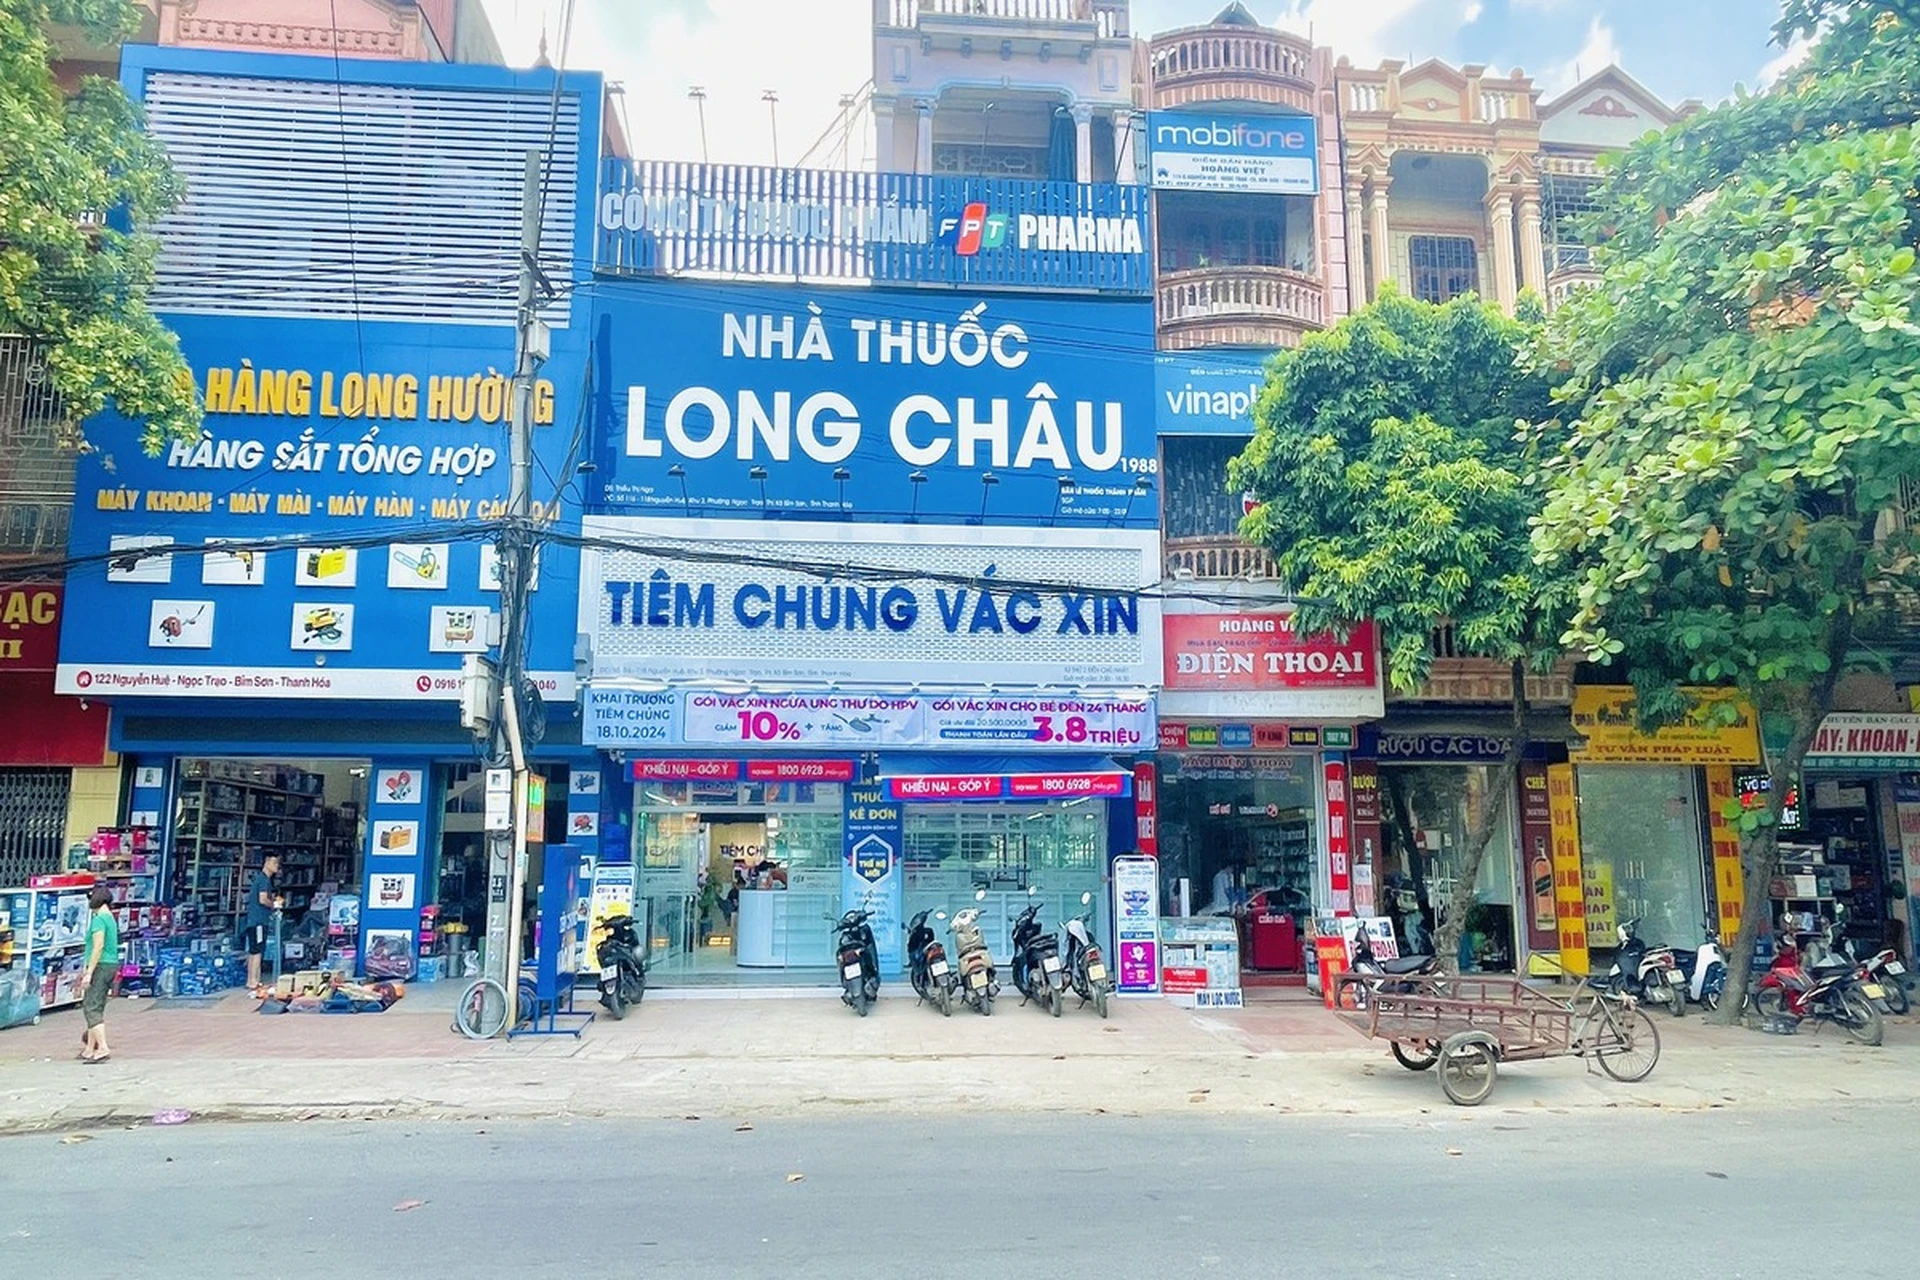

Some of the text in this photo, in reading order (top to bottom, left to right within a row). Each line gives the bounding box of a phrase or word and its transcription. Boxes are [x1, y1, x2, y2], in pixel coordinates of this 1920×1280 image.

[1157, 121, 1305, 149] mobifone
[1201, 165, 1266, 175] HOÀNG VIỆT
[601, 187, 688, 232] CÔNG
[700, 199, 737, 234] TY
[842, 191, 926, 244] PHẨM
[1018, 213, 1143, 254] PHARMA
[722, 300, 1030, 369] NHÀ THUỐC
[205, 358, 312, 416] HÀNG
[320, 370, 418, 420] LONG
[626, 381, 1158, 473] LONG CHÂU 1988
[168, 425, 496, 484] HÀNG SẮT TỔNG HỢP
[97, 483, 140, 510] MÁY
[146, 489, 213, 512] KHOAN
[229, 488, 270, 513] MÁY
[277, 489, 311, 514] MÀI
[328, 490, 369, 516] MÁY
[374, 489, 414, 518] HÀN
[431, 493, 471, 519] MÁY
[605, 568, 714, 627] TIÊM
[1060, 588, 1138, 635] XIN
[0, 591, 57, 630] ẠC
[1219, 618, 1275, 633] HOÀNG
[1177, 645, 1364, 678] ĐIỆN THOẠI
[95, 673, 111, 684] 122
[280, 676, 310, 688] Thanh
[434, 680, 456, 689] 0916
[592, 693, 621, 703] KHAI
[693, 696, 716, 706] GÓI
[747, 699, 767, 708] XIN
[810, 699, 838, 709] UNG
[840, 698, 868, 709] THƯ
[870, 700, 889, 710] DO
[891, 701, 918, 710] HPV
[932, 699, 955, 711] GÓI
[986, 701, 1007, 711] XIN
[1009, 701, 1037, 711] CHO
[1040, 700, 1057, 712] BÉ
[1087, 703, 1102, 712] 24
[595, 706, 670, 720] TIÊM CHỦNG
[1826, 715, 1863, 724] HUYÊN
[597, 725, 667, 738] 18.10.2024
[738, 711, 801, 740] 10%
[972, 729, 994, 738] TOÁN
[1033, 716, 1087, 742] 3.8
[1089, 727, 1141, 746] TRIỆU
[1847, 728, 1909, 752] KHOAN
[1653, 743, 1692, 754] PHÁP
[1696, 744, 1733, 755] LUẬT
[643, 761, 672, 775] KHIẾU
[673, 763, 689, 777] NẠI
[697, 763, 721, 775] GÓP
[722, 762, 730, 774] Ý
[777, 765, 824, 776] 1800 6928
[902, 777, 931, 792] KHIẾU
[931, 781, 949, 795] NẠI
[958, 779, 982, 791] GÓP
[983, 779, 991, 791] Ý
[1042, 778, 1091, 790] 1800 6928
[849, 806, 897, 820] KÊ ĐƠN
